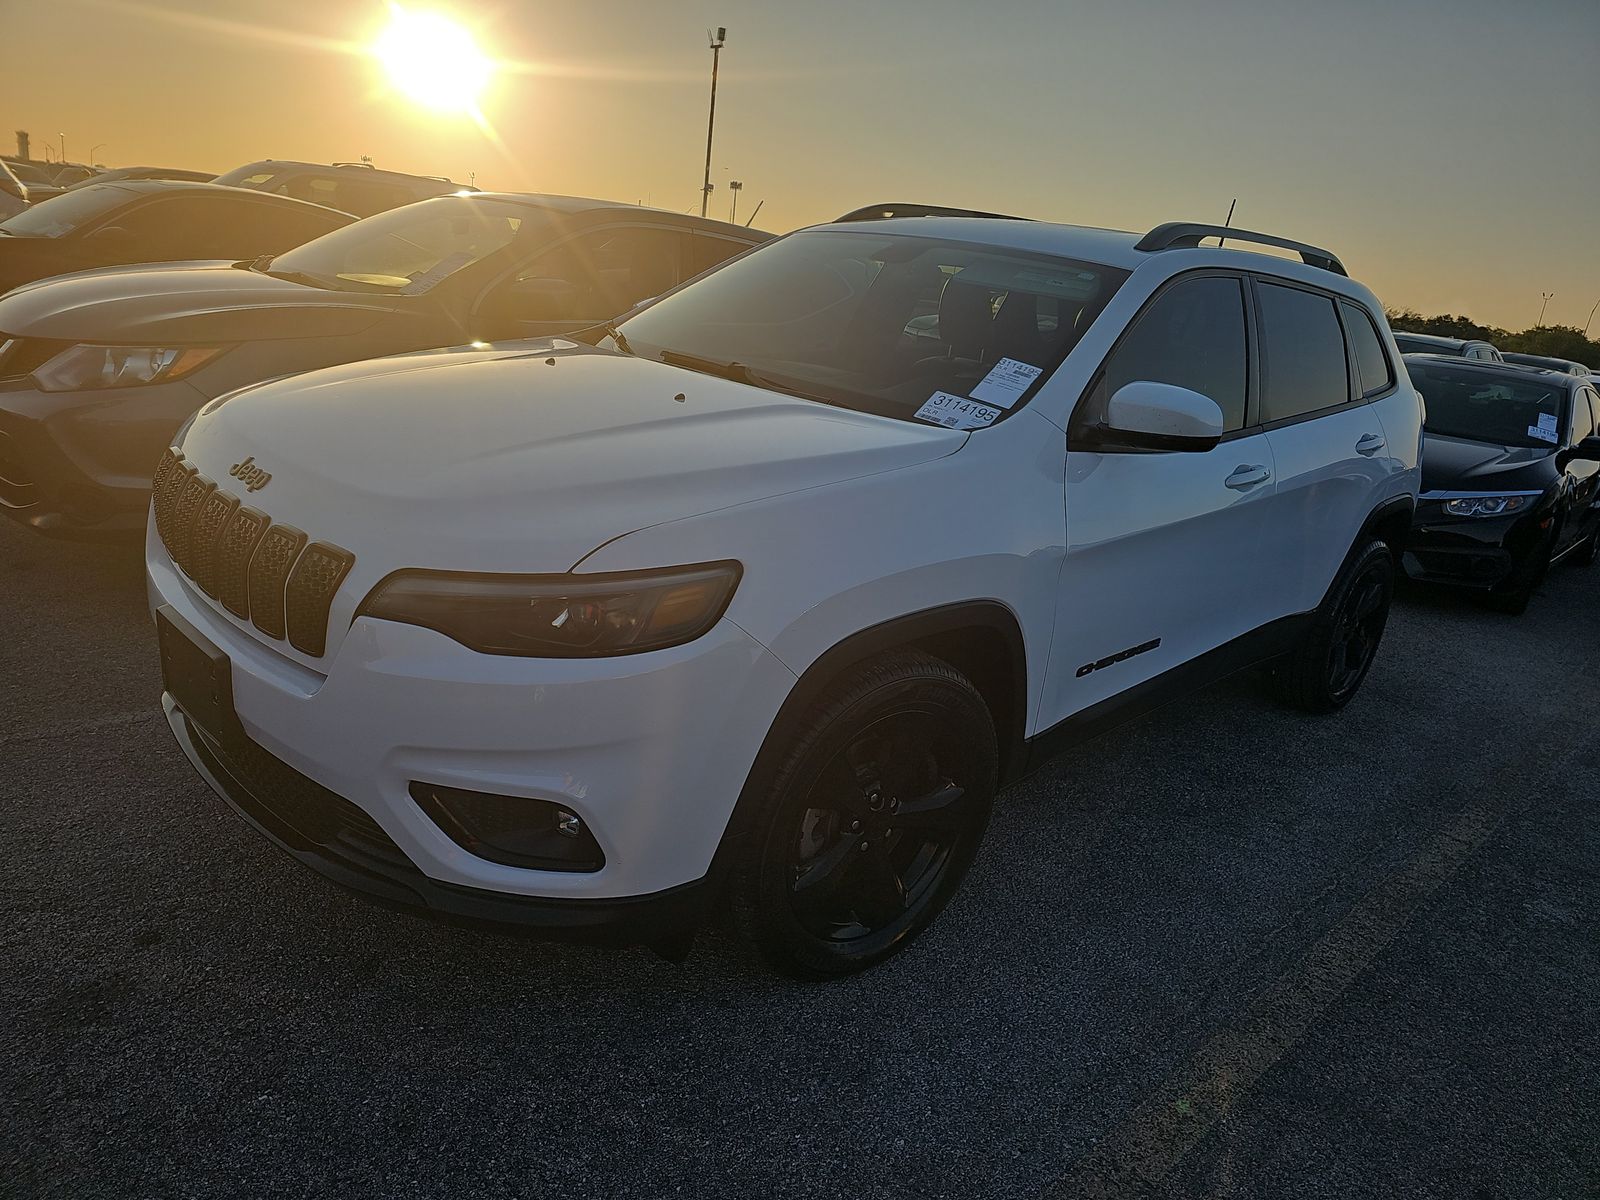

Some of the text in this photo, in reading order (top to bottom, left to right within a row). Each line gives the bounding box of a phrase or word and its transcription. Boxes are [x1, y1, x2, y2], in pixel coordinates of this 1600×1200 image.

[922, 407, 939, 416] DLR
[933, 395, 997, 421] 3114195
[229, 456, 272, 493] Jeep
[1076, 638, 1161, 677] CHEROKEE
